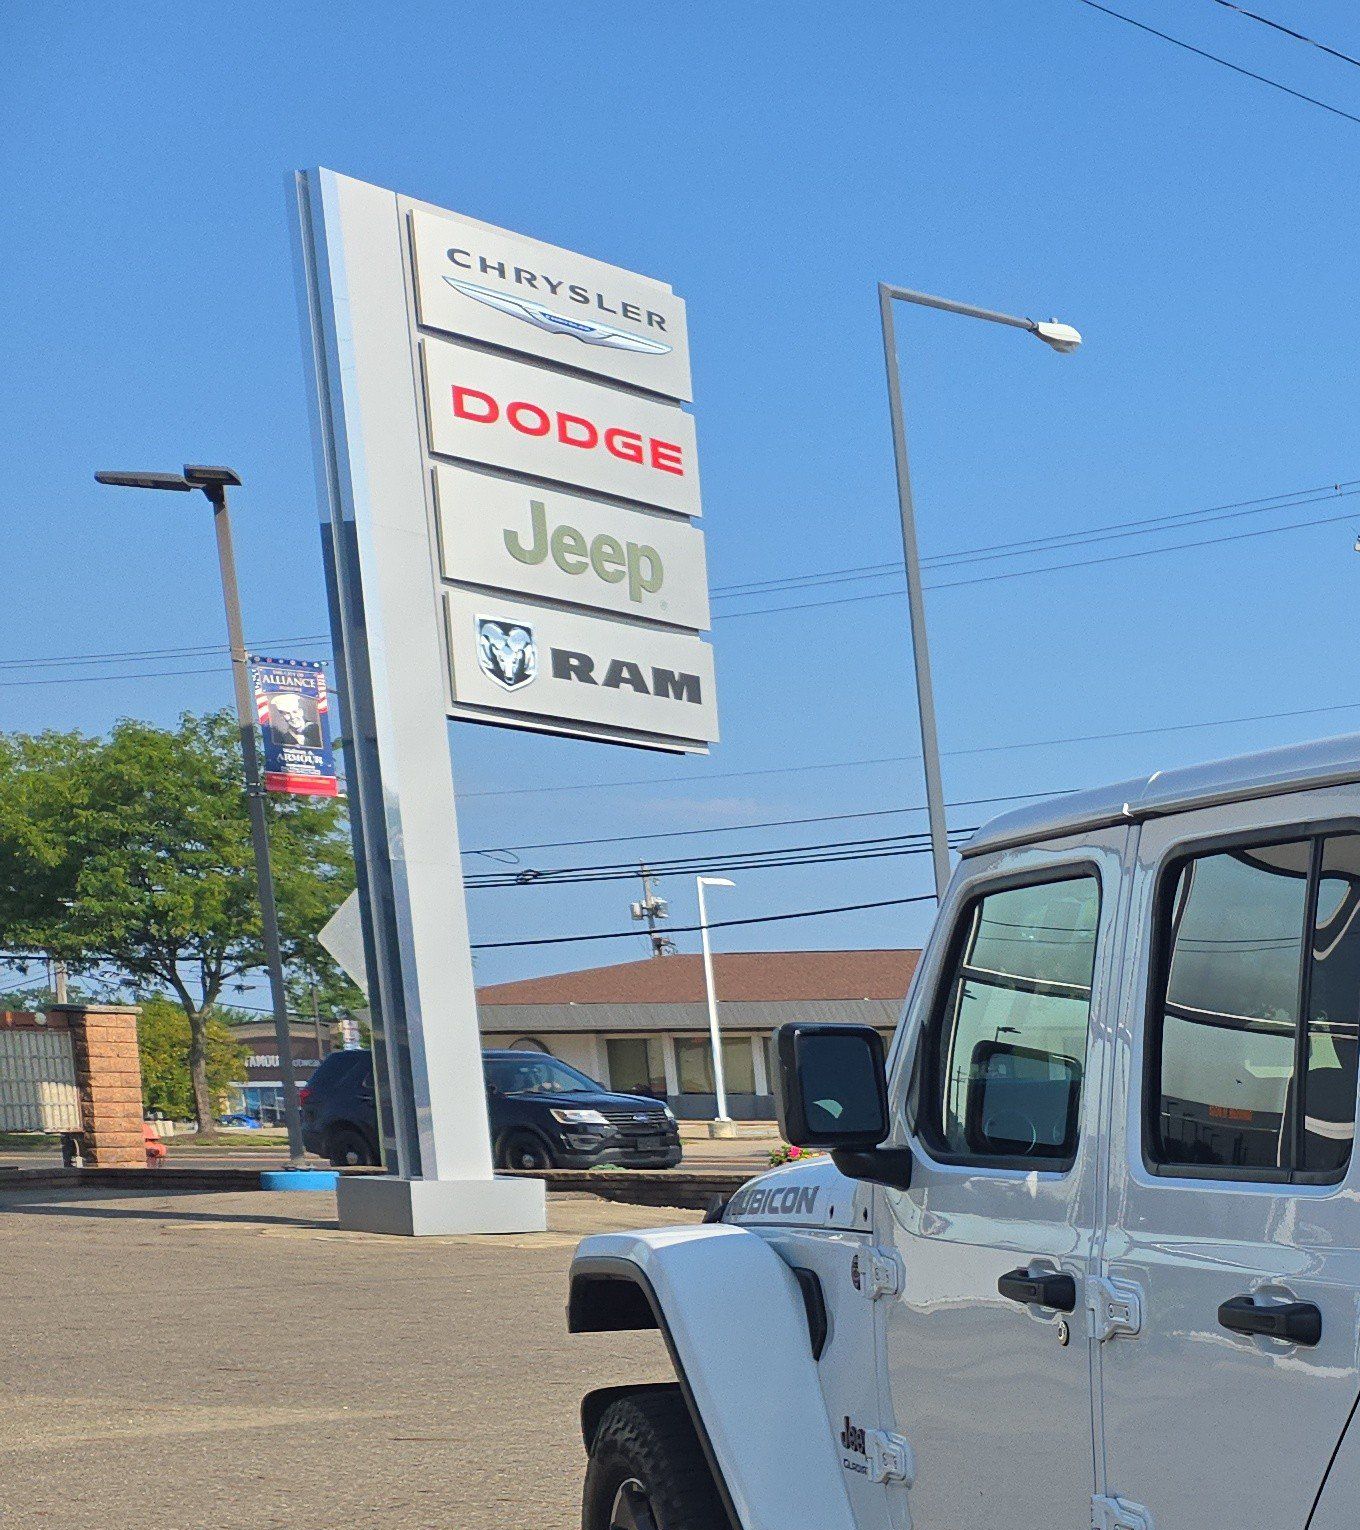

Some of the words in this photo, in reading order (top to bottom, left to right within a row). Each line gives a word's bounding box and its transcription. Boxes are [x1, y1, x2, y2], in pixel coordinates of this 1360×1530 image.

[446, 247, 668, 333] CHRYSLER
[451, 384, 684, 476] DODGE
[503, 499, 664, 603] Jeep
[262, 674, 317, 688] ALLIANCE
[549, 646, 703, 705] RAM
